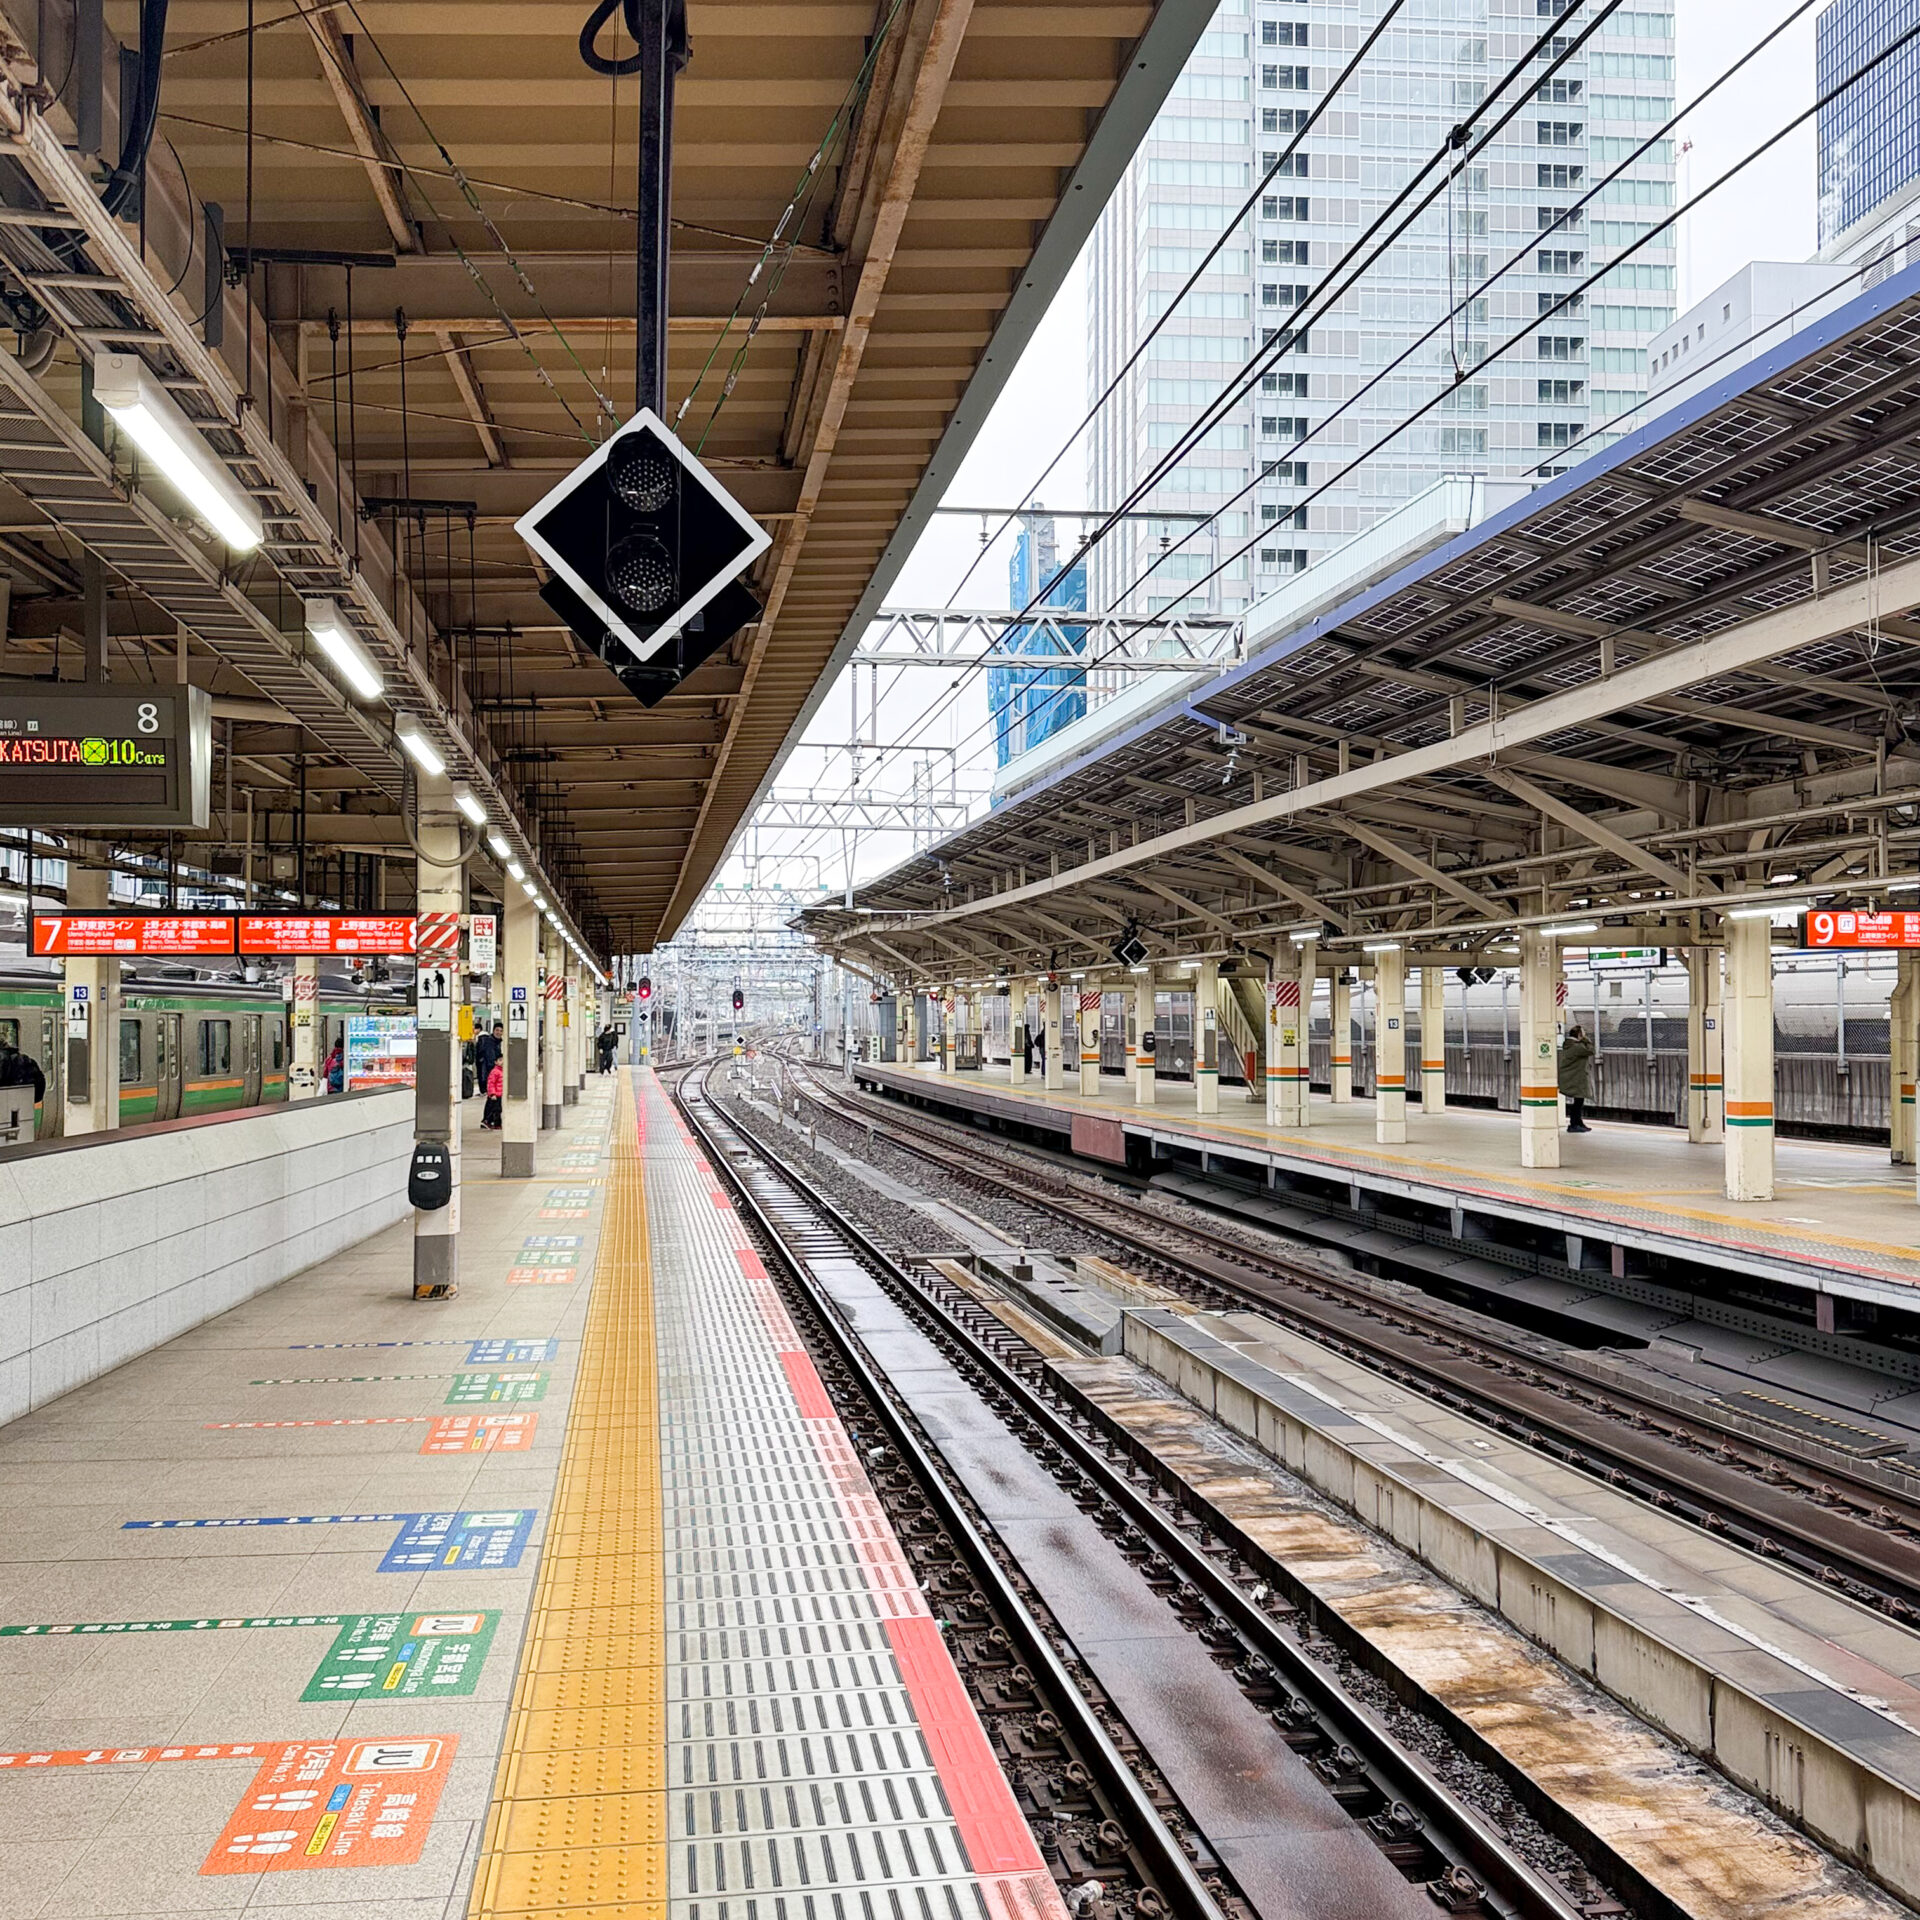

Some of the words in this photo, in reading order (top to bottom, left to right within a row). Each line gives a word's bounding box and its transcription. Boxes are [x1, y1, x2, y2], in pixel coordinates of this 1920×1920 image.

[137, 703, 159, 733] 8
[0, 739, 80, 762] KATSUTA
[41, 920, 62, 951] 7
[67, 920, 134, 931] 上野東京ライン
[338, 920, 404, 931] 上野東京ライン
[1814, 913, 1834, 944] 9
[75, 988, 87, 998] 13
[513, 988, 525, 999] 13
[1389, 1019, 1398, 1028] 13
[369, 1616, 403, 1642] 12号車
[431, 1619, 465, 1631] JU
[430, 1643, 471, 1685] 宇都宮線
[401, 1676, 424, 1693] Line
[281, 1744, 303, 1762] Cars
[294, 1744, 338, 1782] 12号車
[372, 1748, 414, 1766] JU
[268, 1762, 295, 1784] No.12
[345, 1781, 383, 1828] Takasaki
[370, 1792, 418, 1839] 高崎線
[331, 1830, 362, 1856] Line
